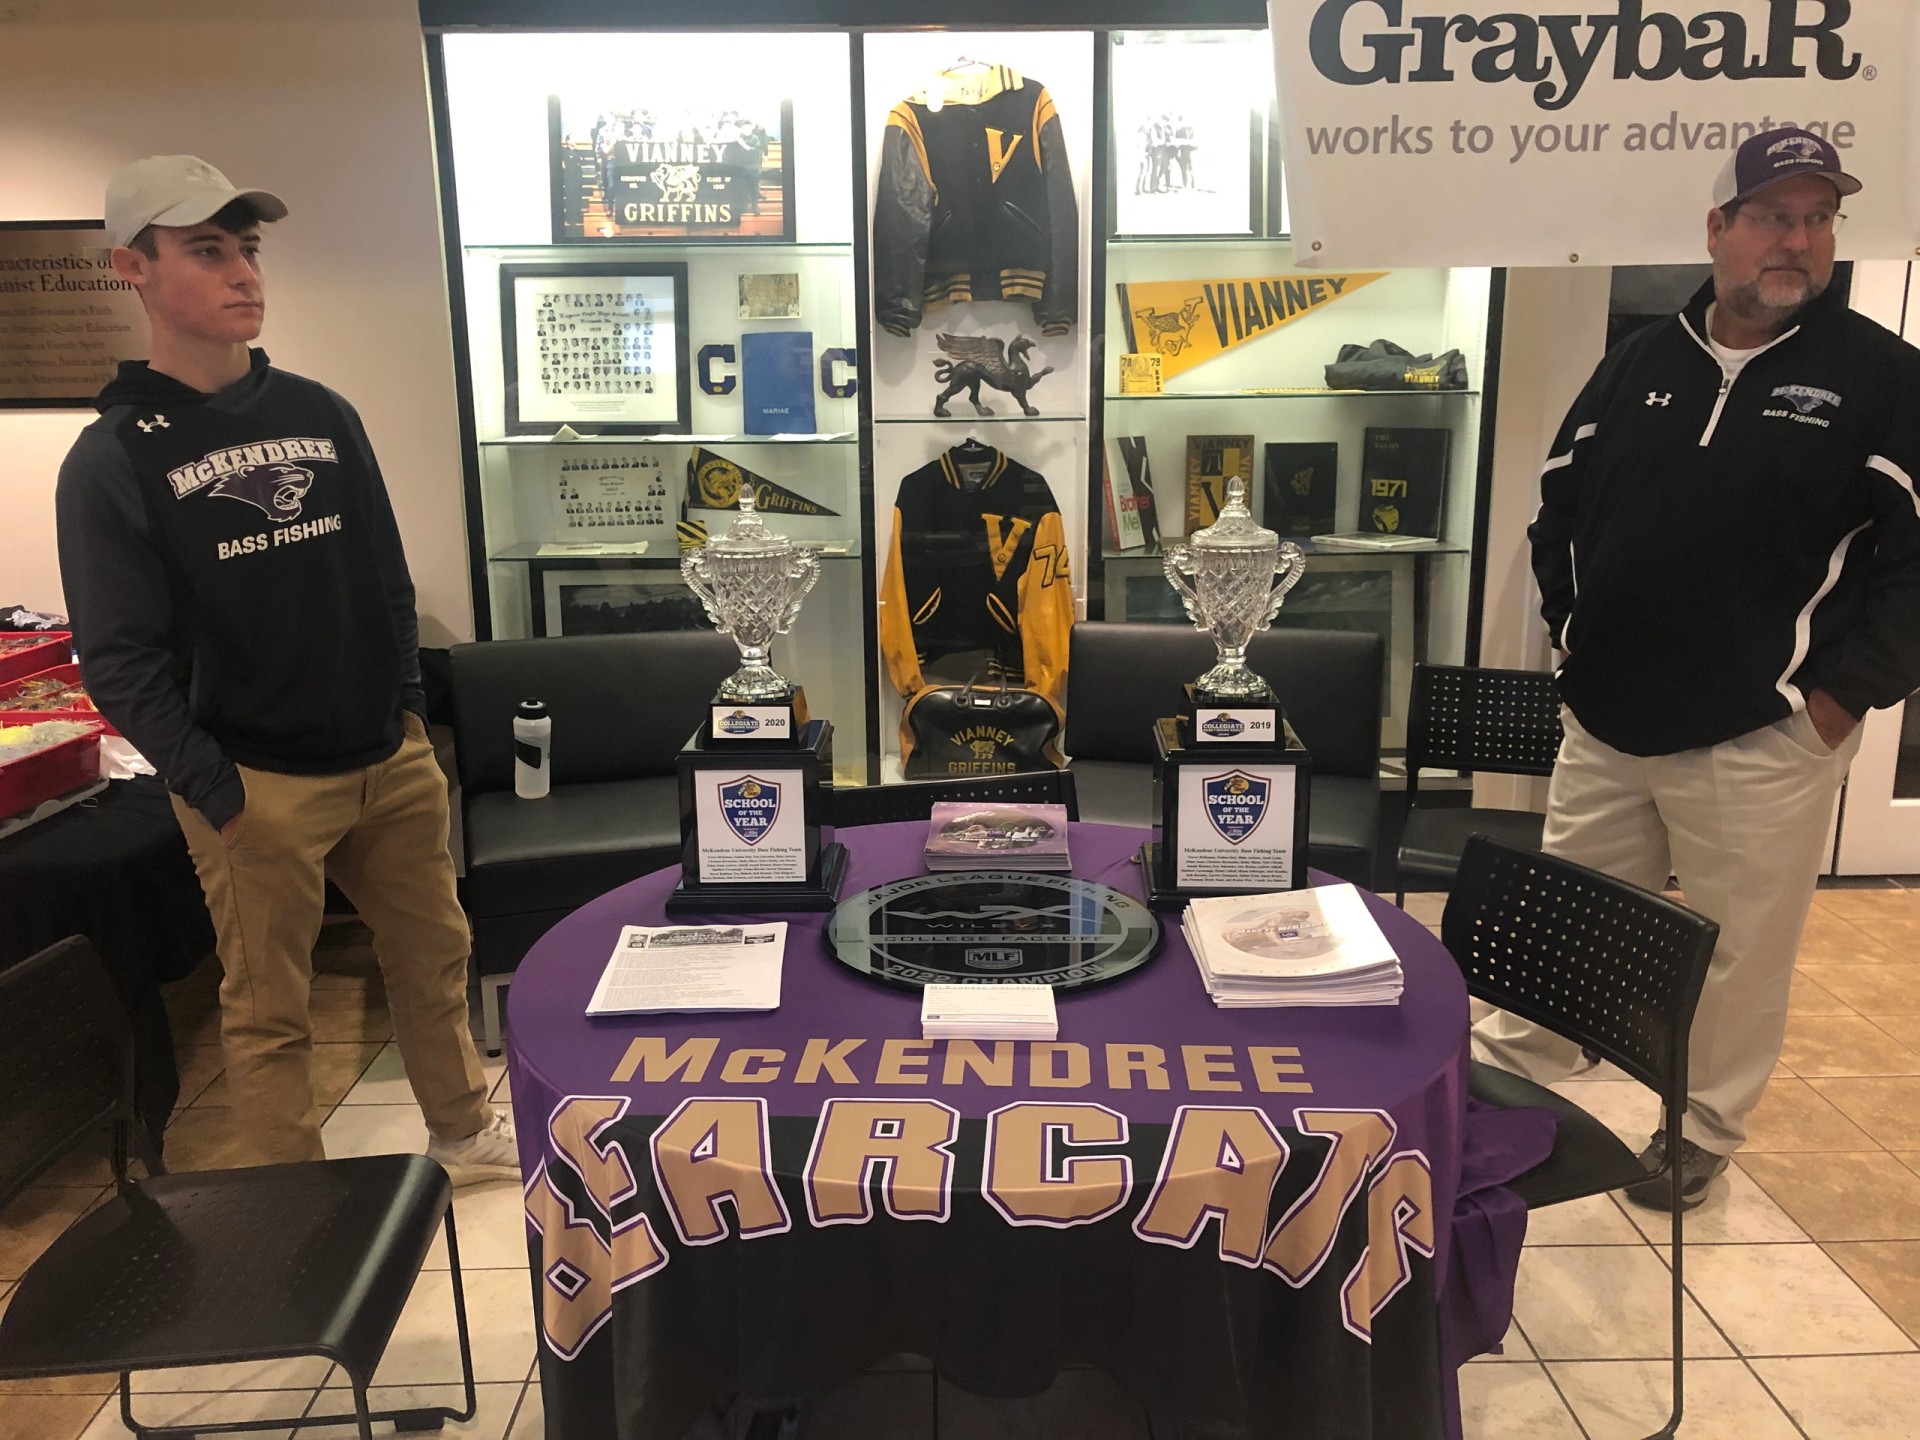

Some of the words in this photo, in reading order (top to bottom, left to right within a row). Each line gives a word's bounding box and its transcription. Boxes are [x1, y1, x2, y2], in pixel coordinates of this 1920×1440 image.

[1306, 114, 1433, 156] works
[1450, 119, 1494, 155] to
[1510, 122, 1618, 164] your
[625, 143, 728, 164] VIANNEY
[624, 203, 732, 223] GRIFFINS
[40, 274, 132, 292] Education
[1203, 277, 1348, 349] VIANNEY
[763, 407, 790, 415] MARIAE
[1762, 408, 1789, 418] BASS
[1789, 412, 1830, 428] FISHING
[168, 438, 338, 498] McKENDREE
[1371, 478, 1408, 498] 1971
[217, 533, 268, 561] BASS
[273, 514, 343, 547] FISHING
[981, 513, 1032, 582] V
[765, 718, 786, 727] 2020
[1250, 721, 1272, 730] 2019
[950, 725, 1016, 747] VIANNEY
[948, 761, 1016, 775] GRIFFINS
[724, 798, 776, 809] SCHOOL
[1208, 795, 1264, 805] SCHOOL
[734, 817, 768, 827] YEAR
[1217, 815, 1254, 824] YEAR
[936, 873, 1041, 884] LEAGUE
[972, 951, 1015, 963] MLF
[887, 964, 950, 984] 2022
[611, 1037, 1313, 1095] McKENDREE
